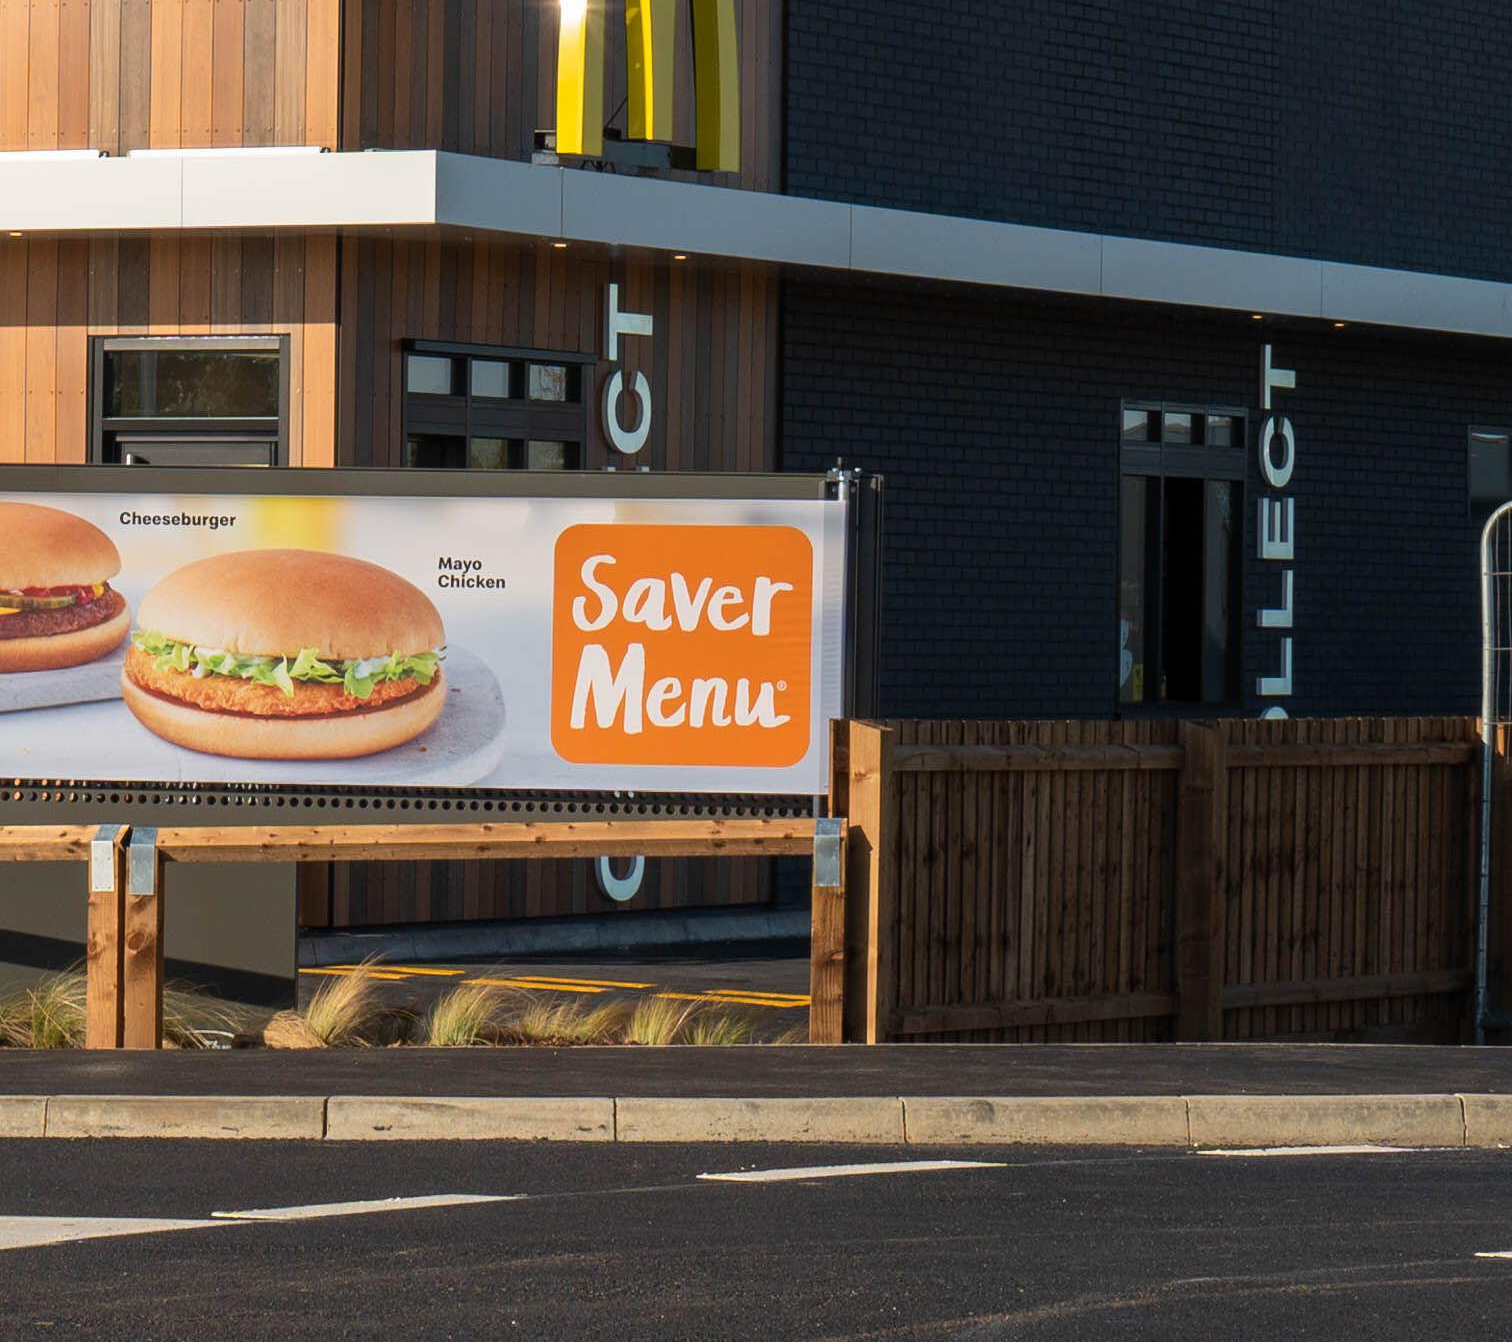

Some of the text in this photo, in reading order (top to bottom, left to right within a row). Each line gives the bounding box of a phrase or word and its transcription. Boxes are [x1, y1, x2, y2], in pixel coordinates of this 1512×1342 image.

[119, 511, 237, 530] Cheeseburger
[1257, 344, 1297, 720] LLECT
[438, 557, 482, 574] Mayo
[438, 574, 506, 589] Chicken
[572, 554, 794, 636] Saver
